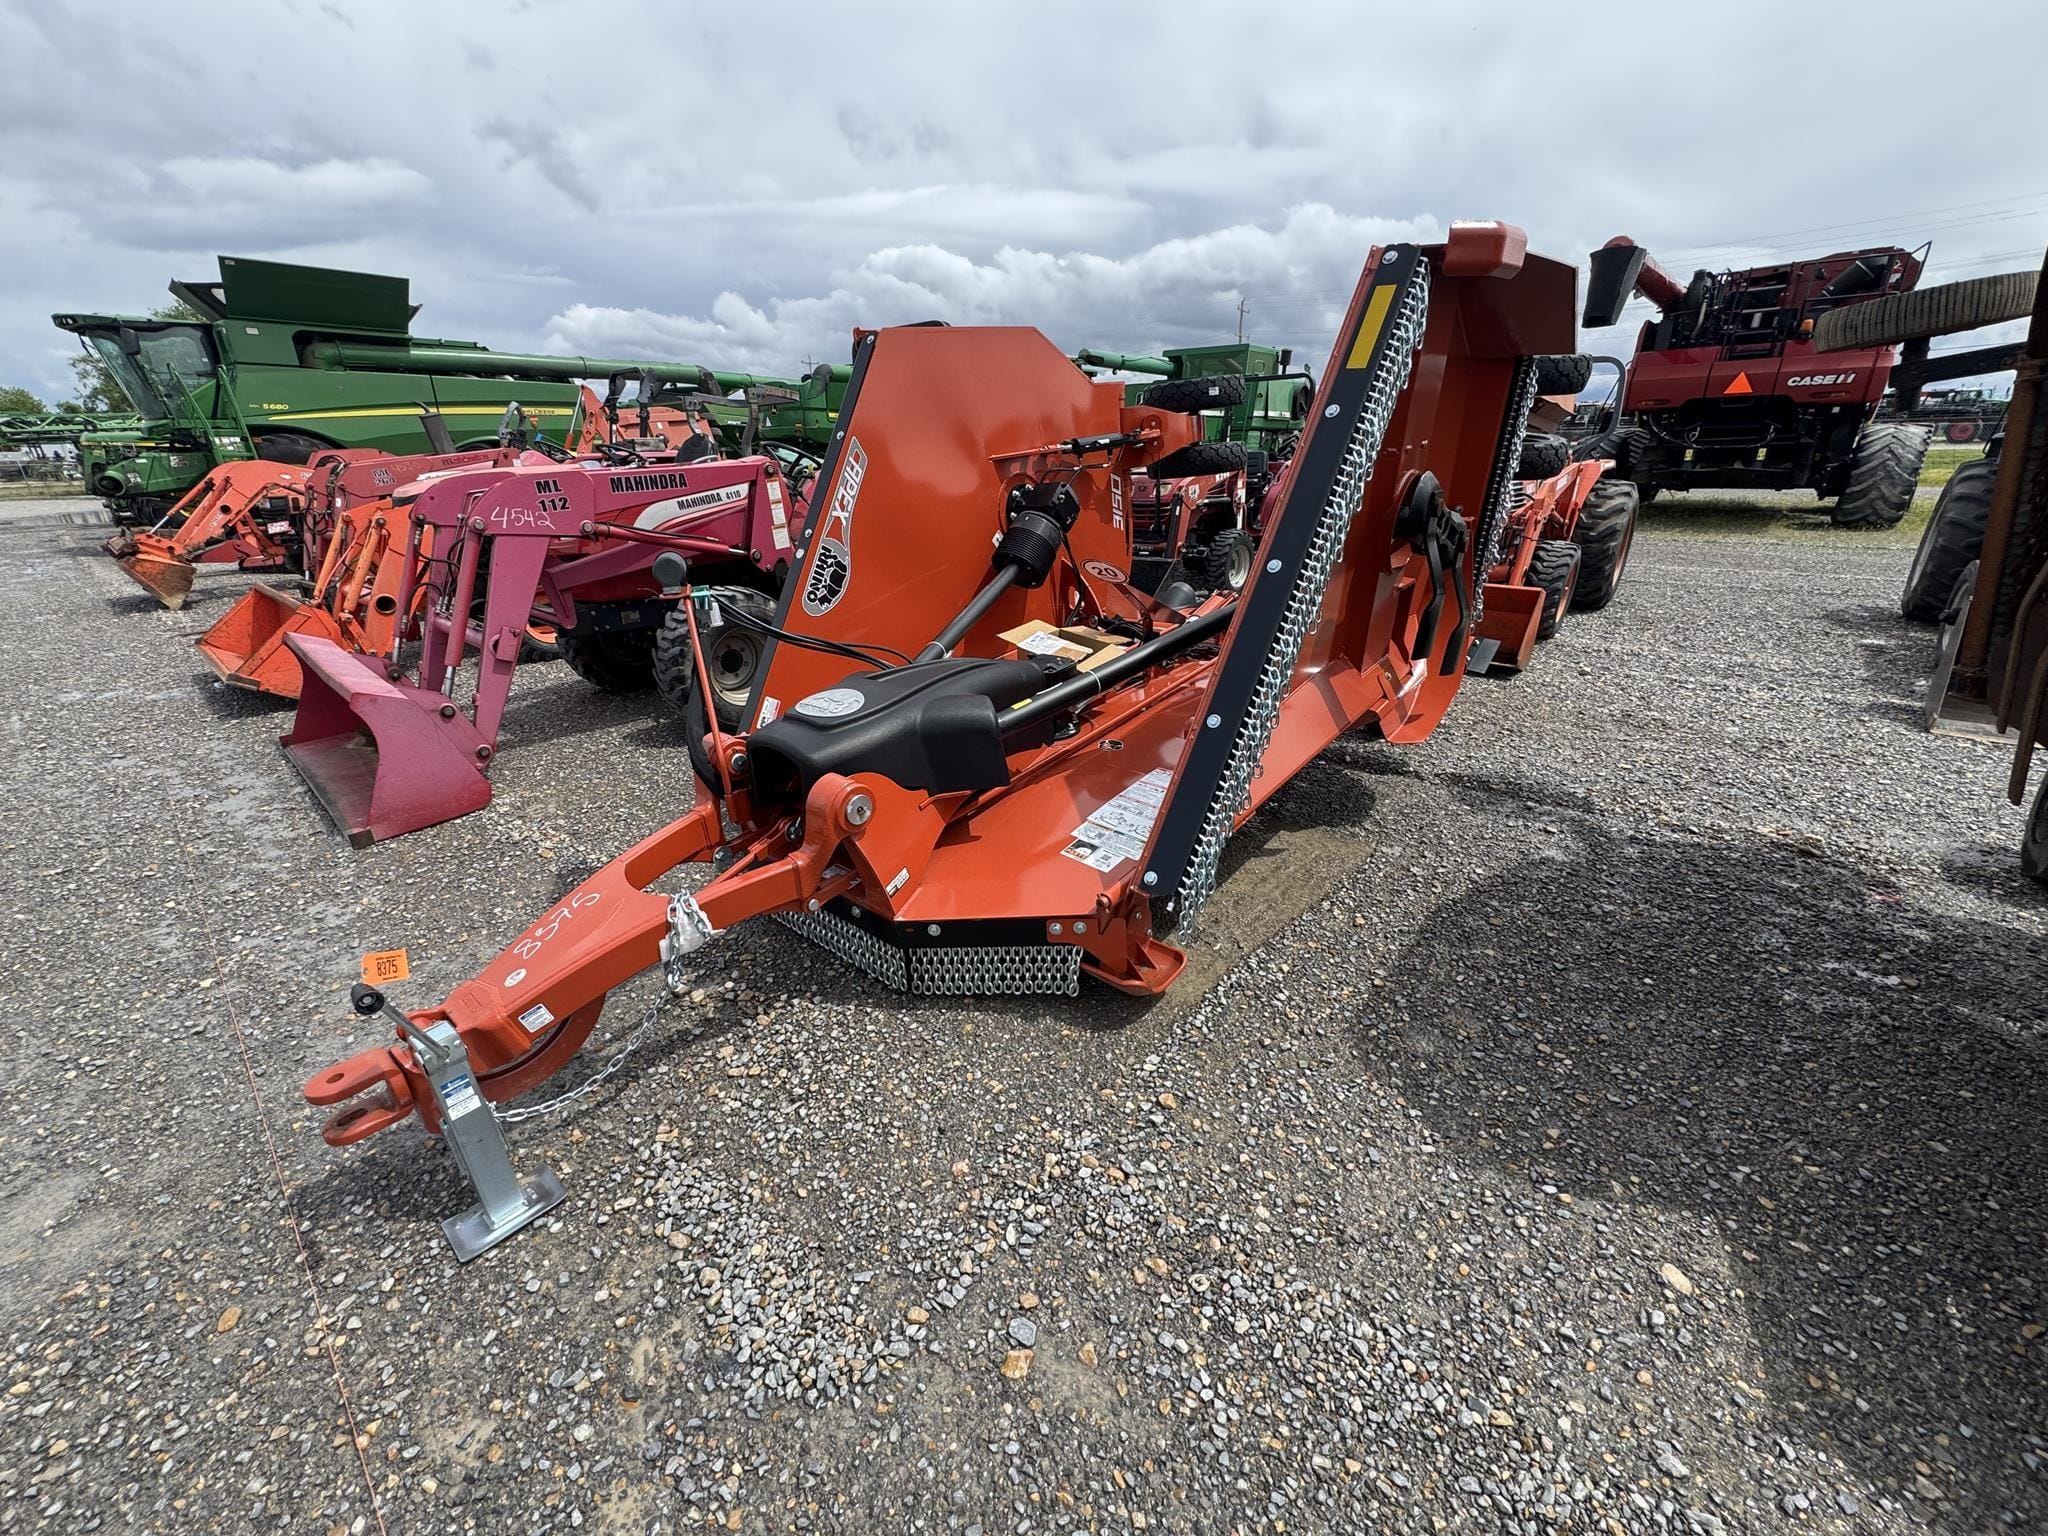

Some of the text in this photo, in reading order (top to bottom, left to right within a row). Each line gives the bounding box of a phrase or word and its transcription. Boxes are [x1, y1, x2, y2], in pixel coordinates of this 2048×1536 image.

[1786, 374, 1838, 387] CASE
[535, 479, 563, 495] ML
[609, 472, 688, 493] MAHINDRA
[831, 454, 863, 527] APEX
[537, 496, 571, 513] 112
[676, 492, 723, 511] MAHINDRA
[490, 506, 557, 530] 4542
[805, 544, 839, 604] RHINO
[1091, 566, 1118, 578] 20
[376, 959, 398, 977] 8375
